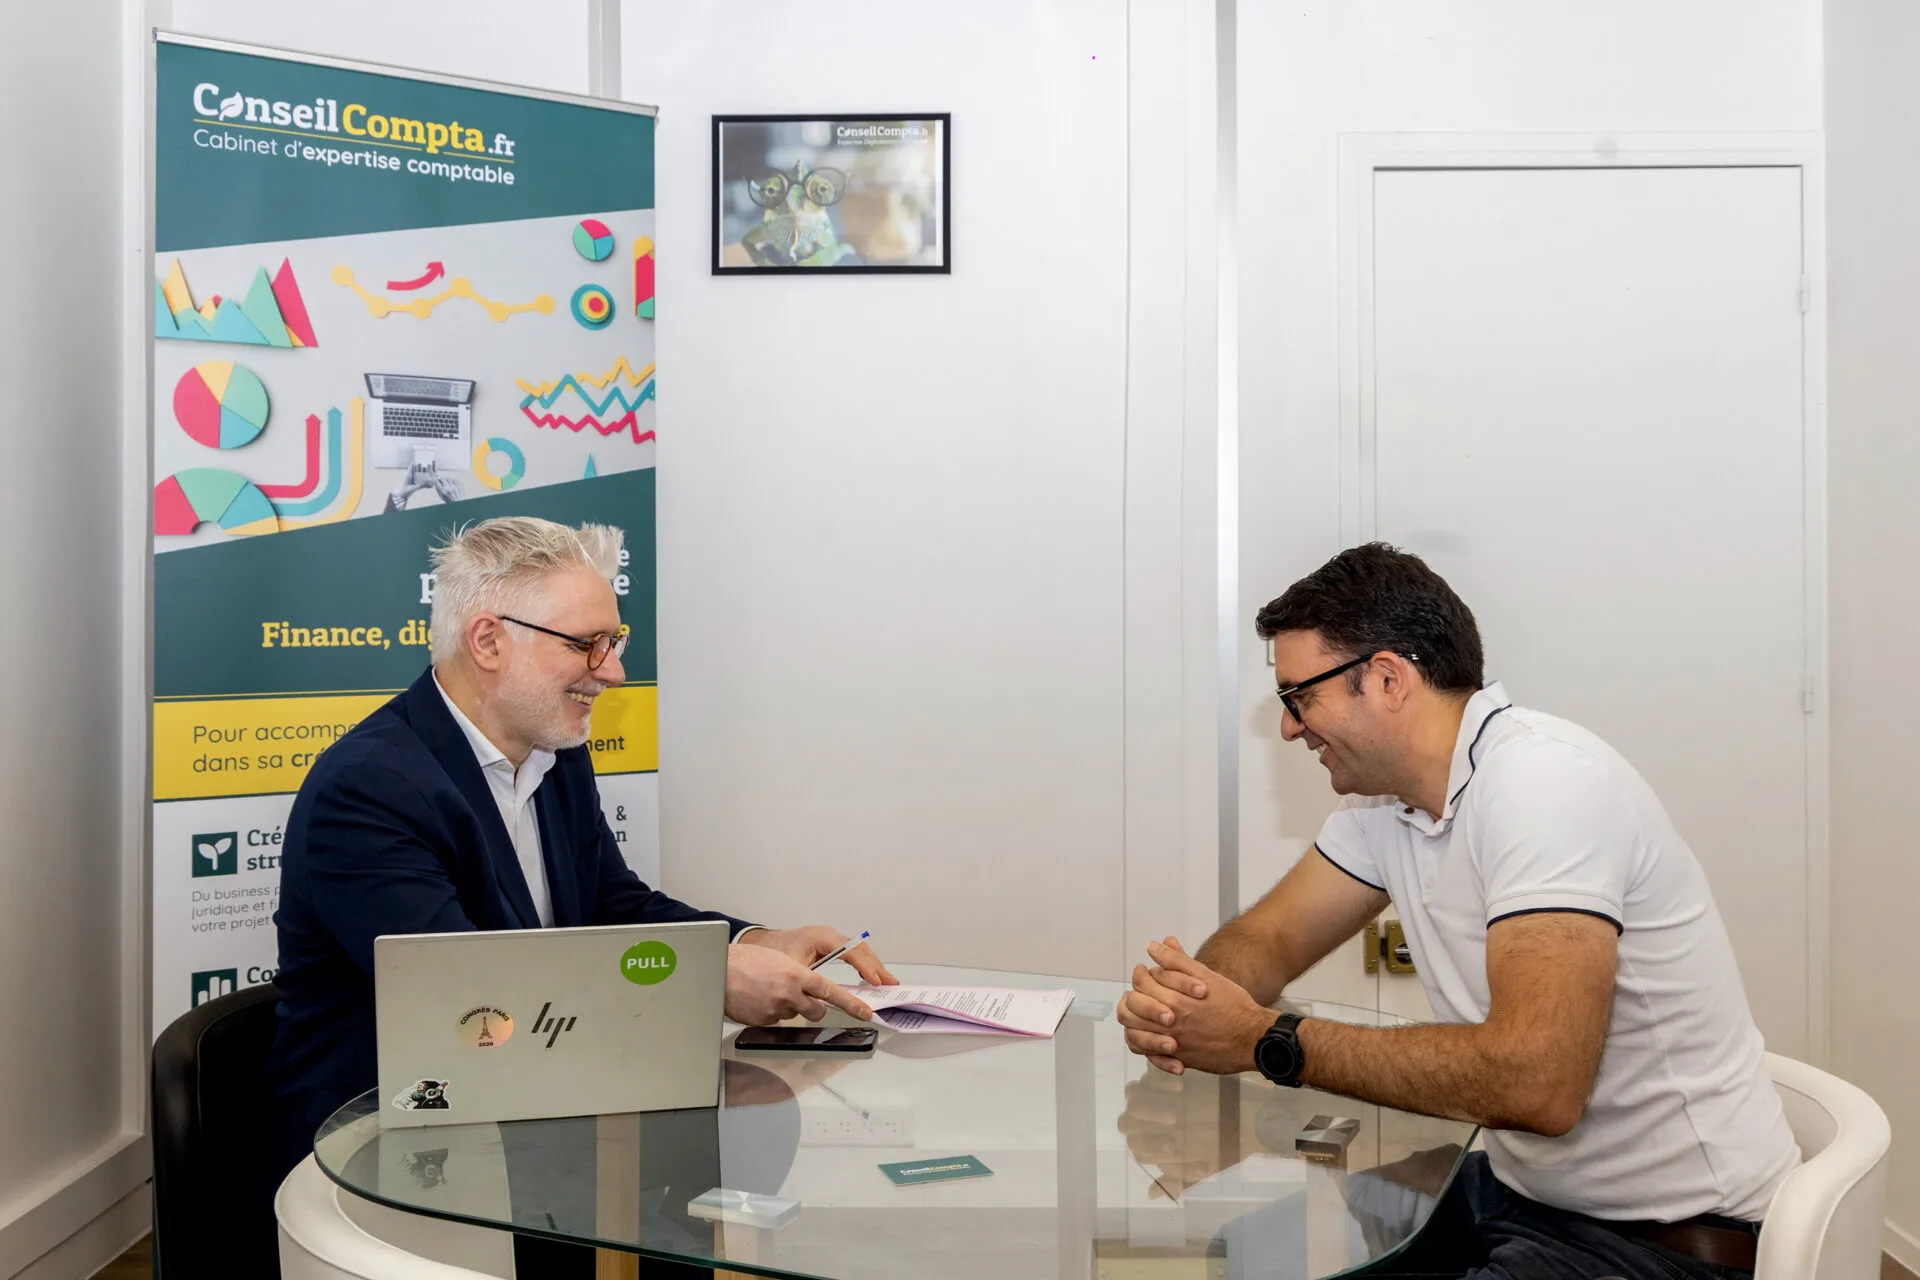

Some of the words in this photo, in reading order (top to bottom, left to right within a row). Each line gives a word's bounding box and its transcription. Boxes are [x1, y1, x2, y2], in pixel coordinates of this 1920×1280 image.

[193, 128, 278, 156] Cabinet
[284, 139, 401, 171] d'expertise
[406, 158, 516, 186] comptable
[261, 621, 392, 651] Finance,
[193, 725, 248, 744] Pour
[192, 753, 250, 773] dans
[257, 754, 283, 769] sa
[616, 805, 627, 821] &
[247, 825, 282, 847] Cré
[192, 890, 210, 902] Du
[214, 886, 270, 900] business
[191, 903, 249, 920] juridique
[253, 901, 266, 912] et
[191, 920, 227, 933] votre
[230, 915, 269, 931] projet
[626, 956, 670, 970] PULL
